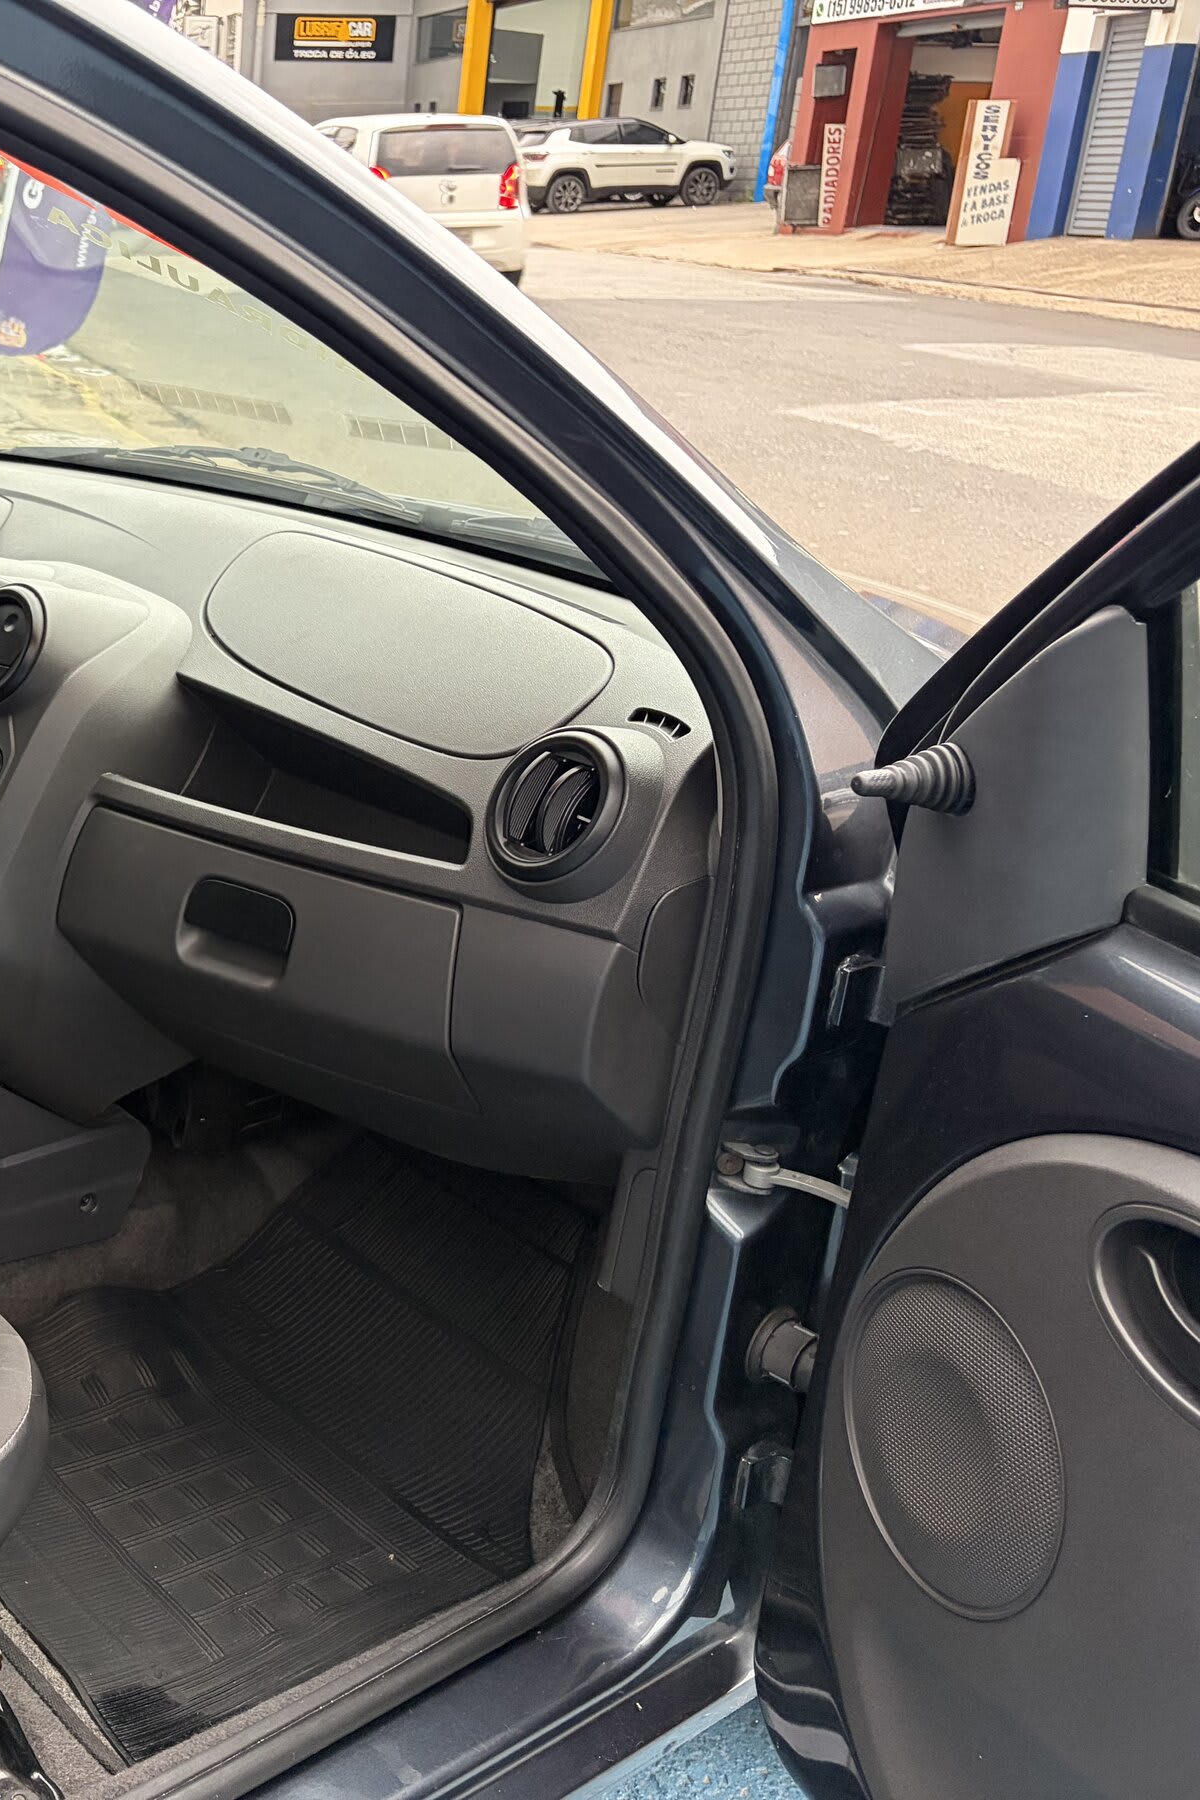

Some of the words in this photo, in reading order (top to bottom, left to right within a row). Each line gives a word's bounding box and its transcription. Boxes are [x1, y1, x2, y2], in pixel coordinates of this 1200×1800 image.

[827, 0, 847, 18] (15)
[293, 49, 328, 59] TROCA
[329, 50, 345, 59] DE
[822, 127, 842, 224] RADIADORES
